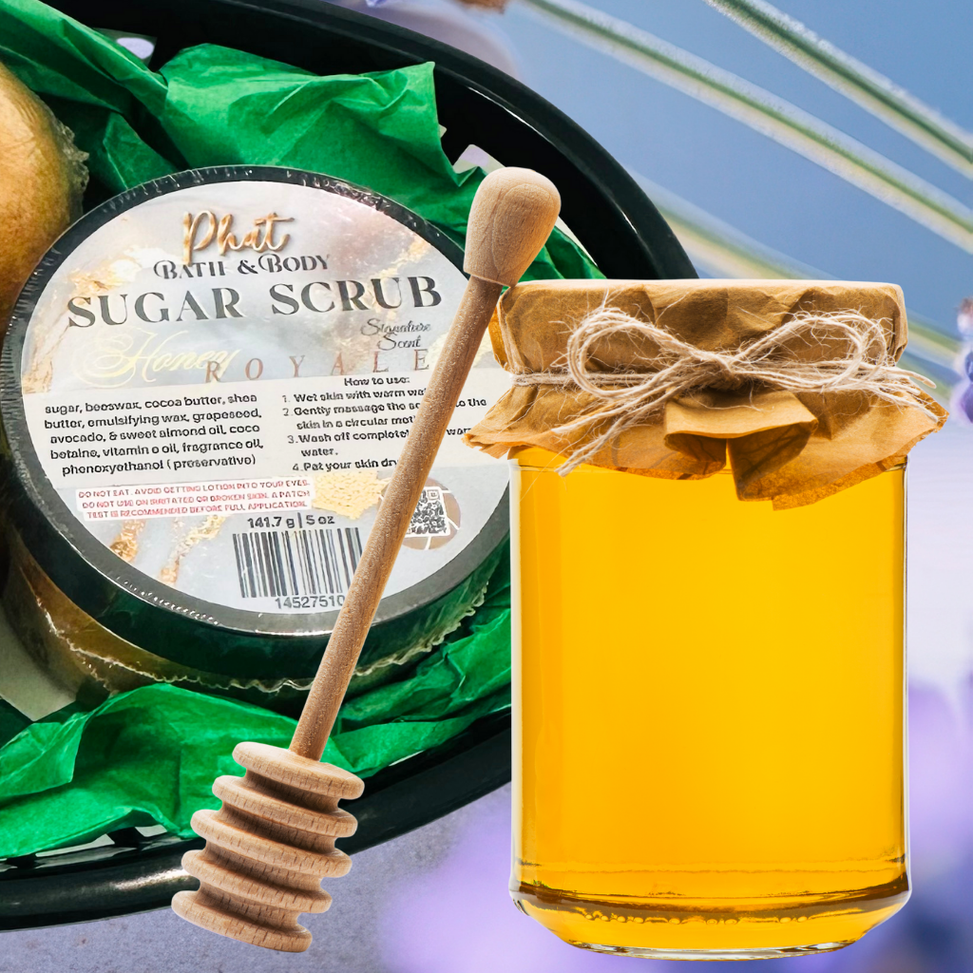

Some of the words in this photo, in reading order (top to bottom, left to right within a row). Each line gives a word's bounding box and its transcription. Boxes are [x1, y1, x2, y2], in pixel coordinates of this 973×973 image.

[182, 209, 295, 266] Phat
[153, 259, 226, 280] BATH
[237, 258, 258, 275] &
[258, 253, 330, 273] BODY
[67, 287, 244, 328] SUGAR
[268, 275, 442, 315] SCRUB
[72, 328, 243, 390] Honey
[205, 348, 429, 384] ROYALE
[391, 415, 416, 425] mot
[467, 397, 487, 408] the
